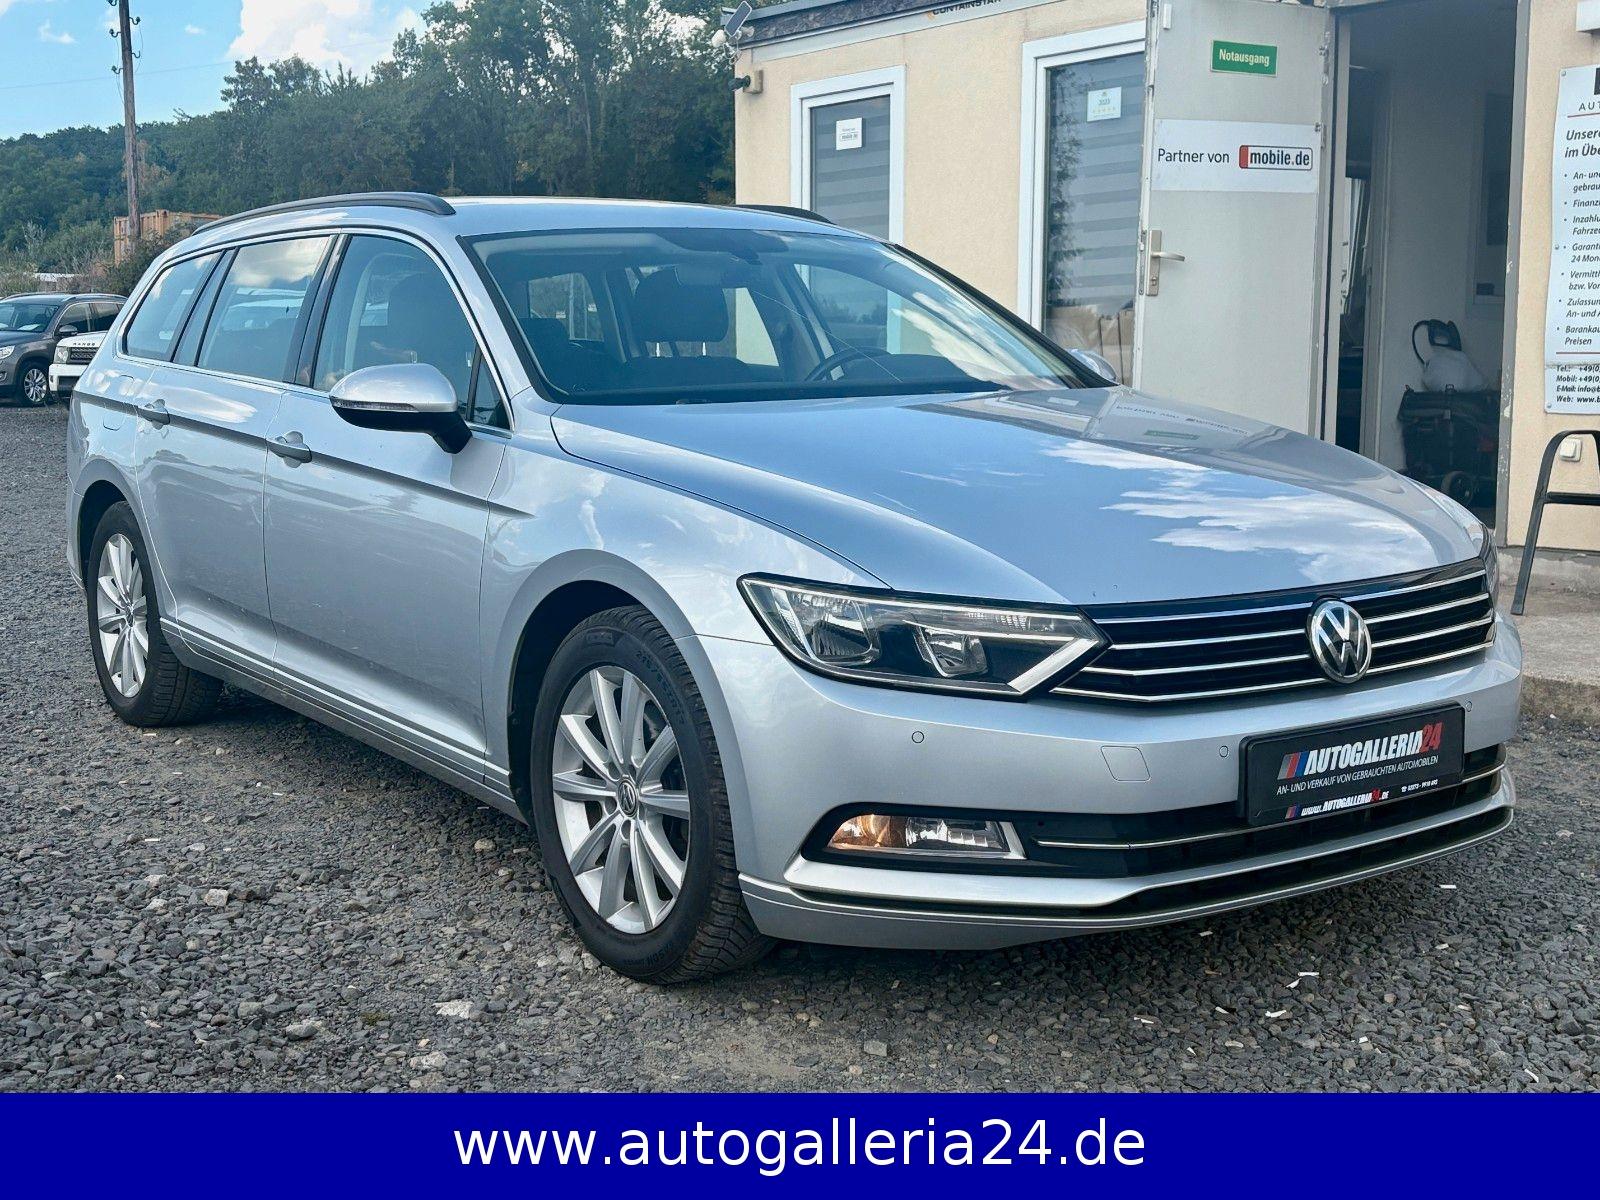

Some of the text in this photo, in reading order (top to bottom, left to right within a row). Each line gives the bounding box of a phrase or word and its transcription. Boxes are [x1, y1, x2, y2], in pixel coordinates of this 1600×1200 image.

[1219, 49, 1270, 67] Notausgang
[1158, 148, 1310, 166] Partner von mobile.de
[1564, 147, 1579, 158] im
[1573, 171, 1587, 180] An-
[1573, 199, 1600, 208] Finanz
[1571, 255, 1581, 263] 24
[1568, 282, 1586, 290] bzw.
[1566, 309, 1580, 318] An-
[1581, 309, 1597, 318] und
[1564, 336, 1592, 346] Preisen
[1303, 721, 1444, 776] AUTOGALLERIA24
[1276, 755, 1439, 796] AN- UND VERKAUF VON GEBRAUCHTEN AUTOMOBILEN
